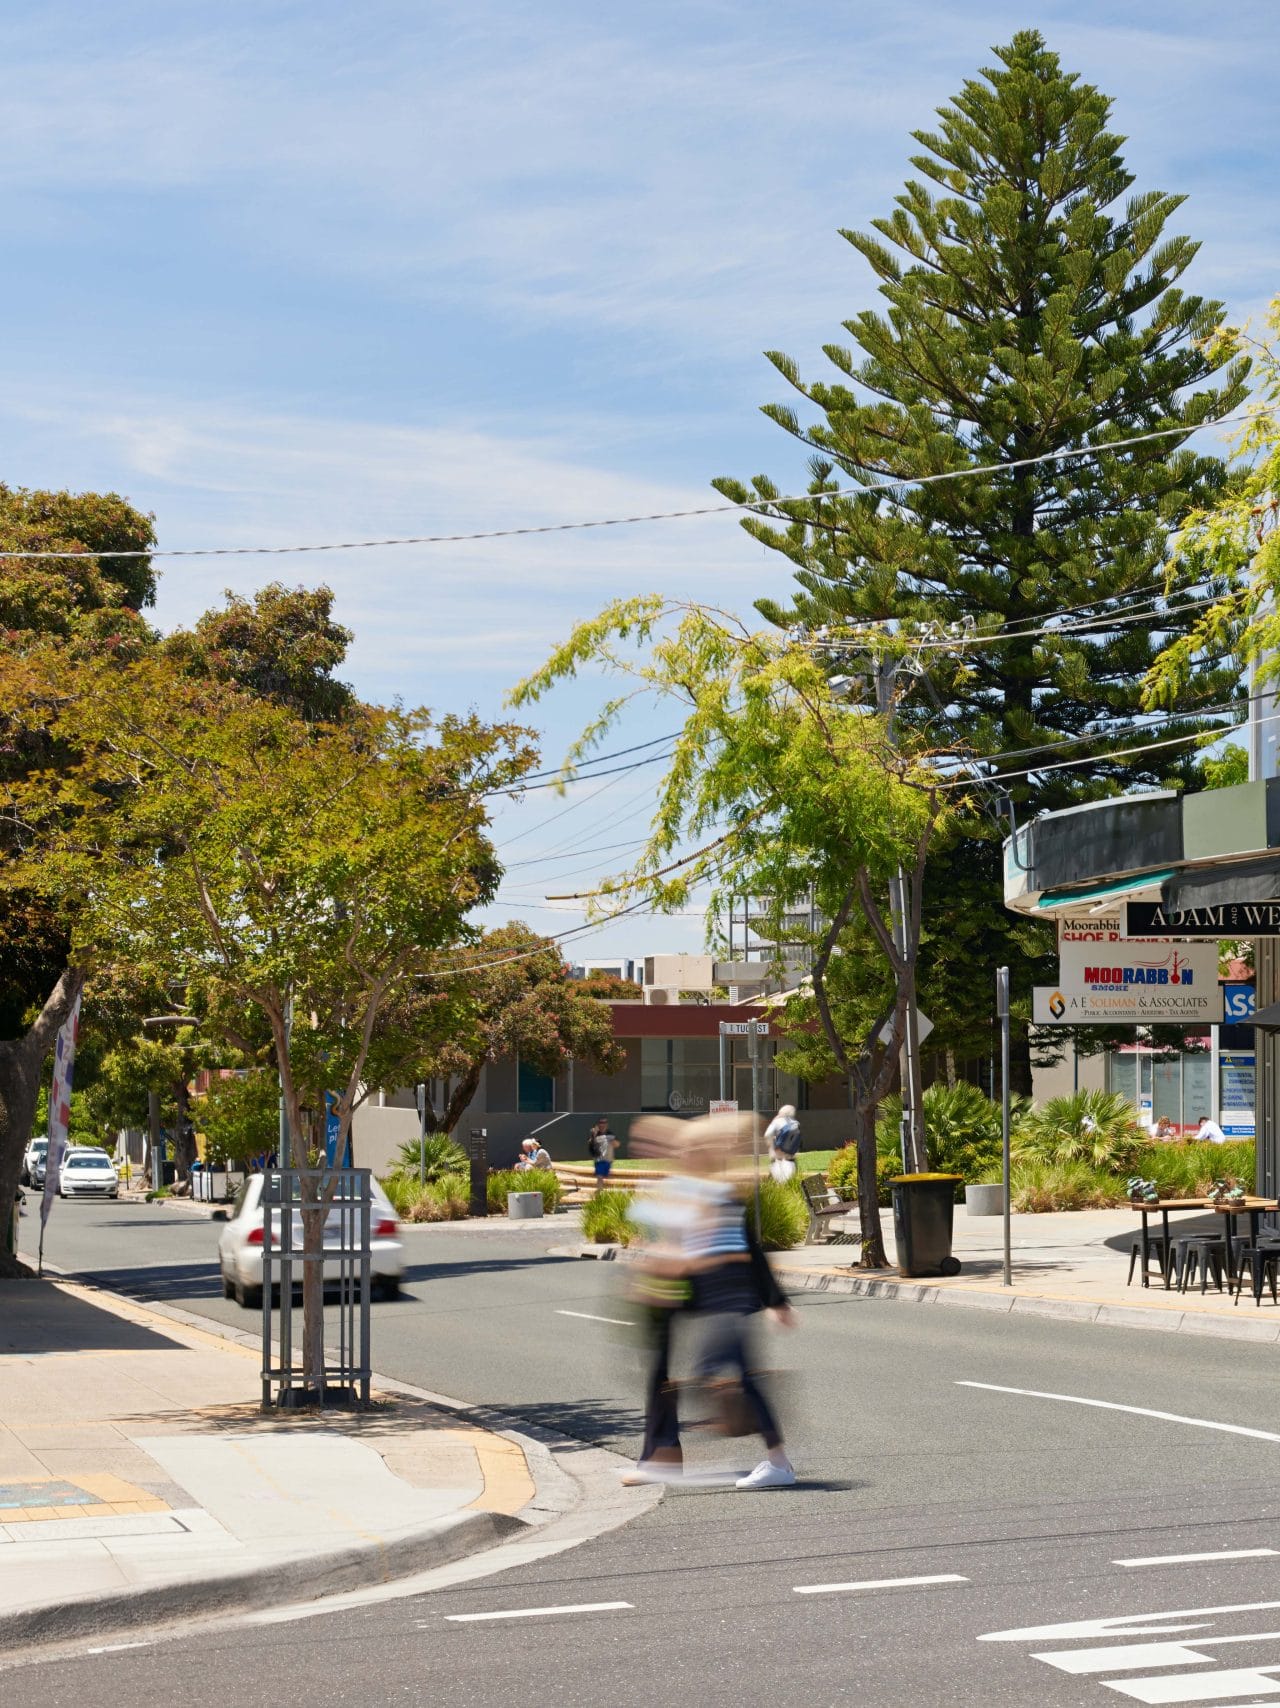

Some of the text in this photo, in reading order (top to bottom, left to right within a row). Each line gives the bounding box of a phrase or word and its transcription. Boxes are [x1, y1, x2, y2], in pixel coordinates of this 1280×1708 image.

[1070, 996, 1208, 1008] A E SOLIMAN & ASSOCIATES
[757, 1024, 766, 1033] ST
